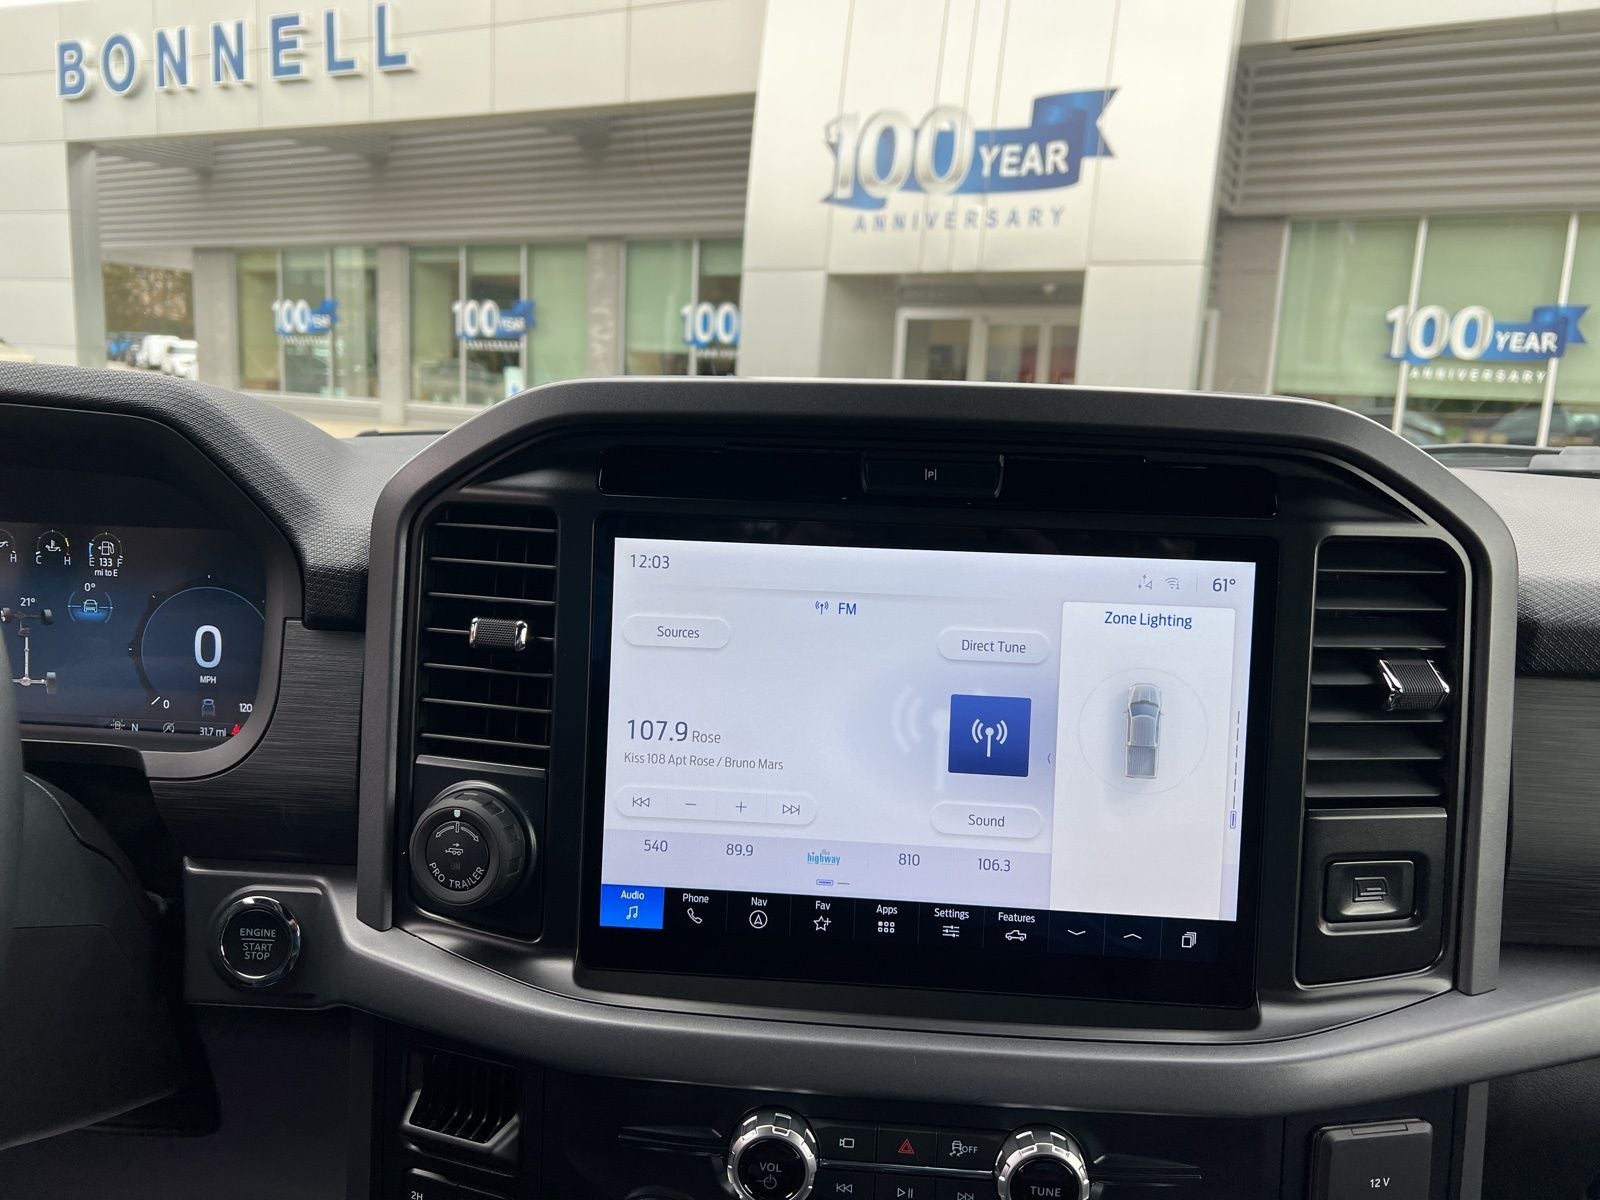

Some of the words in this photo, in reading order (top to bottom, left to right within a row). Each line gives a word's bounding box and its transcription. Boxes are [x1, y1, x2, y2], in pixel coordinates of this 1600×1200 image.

[56, 2, 411, 98] BONNELL
[823, 104, 976, 199] 100
[978, 140, 1069, 178] YEAR
[853, 206, 1065, 234] ANNIVERSARY
[271, 299, 312, 333] 100
[452, 300, 500, 337] 100
[680, 302, 738, 343] 100
[1385, 305, 1494, 360] 100
[1495, 330, 1558, 353] YEAR
[1408, 367, 1548, 384] ANNIVERSARY
[10, 553, 17, 563] H
[35, 555, 42, 565] C
[63, 556, 71, 566] H
[89, 557, 95, 567] E
[99, 557, 113, 567] 133
[117, 558, 123, 568] F
[630, 554, 670, 569] 12:03
[94, 568, 104, 577] mi
[104, 568, 112, 577] to
[113, 569, 118, 577] E
[838, 602, 857, 615] FM
[1104, 611, 1137, 625] Zone
[1139, 613, 1193, 630] Lighting
[657, 625, 700, 639] Sources
[194, 624, 222, 669] 0
[961, 639, 995, 652] Direct
[998, 641, 1026, 654] Tune
[200, 676, 217, 684] MPH
[163, 700, 170, 709] 0
[239, 703, 253, 713] 120
[131, 723, 139, 732] N
[215, 728, 227, 737] mi
[627, 719, 688, 742] 107.9
[691, 731, 721, 744] Rose
[624, 752, 645, 764] Kiss
[647, 753, 666, 765] 108
[668, 754, 687, 768] Apt
[689, 755, 715, 767] Rose
[724, 757, 756, 769] Bruno
[758, 758, 784, 770] Mars
[968, 814, 1005, 828] Sound
[644, 840, 668, 852] 540
[726, 844, 754, 857] 89.9
[807, 852, 840, 866] highway
[898, 853, 920, 866] 810
[977, 858, 1011, 872] 106.3
[428, 861, 446, 883] PRO
[448, 866, 485, 889] TRAILER
[620, 890, 645, 900] Audio
[682, 893, 709, 904] Phone
[751, 897, 768, 907] Nav
[815, 901, 831, 911] Fav
[876, 904, 898, 916] Apps
[934, 908, 970, 921] Settings
[998, 912, 1036, 923] Features
[239, 928, 277, 938] ENGINE
[242, 942, 273, 952] START
[244, 950, 271, 961] STOP
[963, 1146, 978, 1154] OFF
[759, 1162, 782, 1173] VOL
[1369, 1178, 1381, 1188] 12
[1383, 1177, 1390, 1187] V
[410, 1190, 423, 1200] 2H
[1030, 1186, 1061, 1197] TUNE
